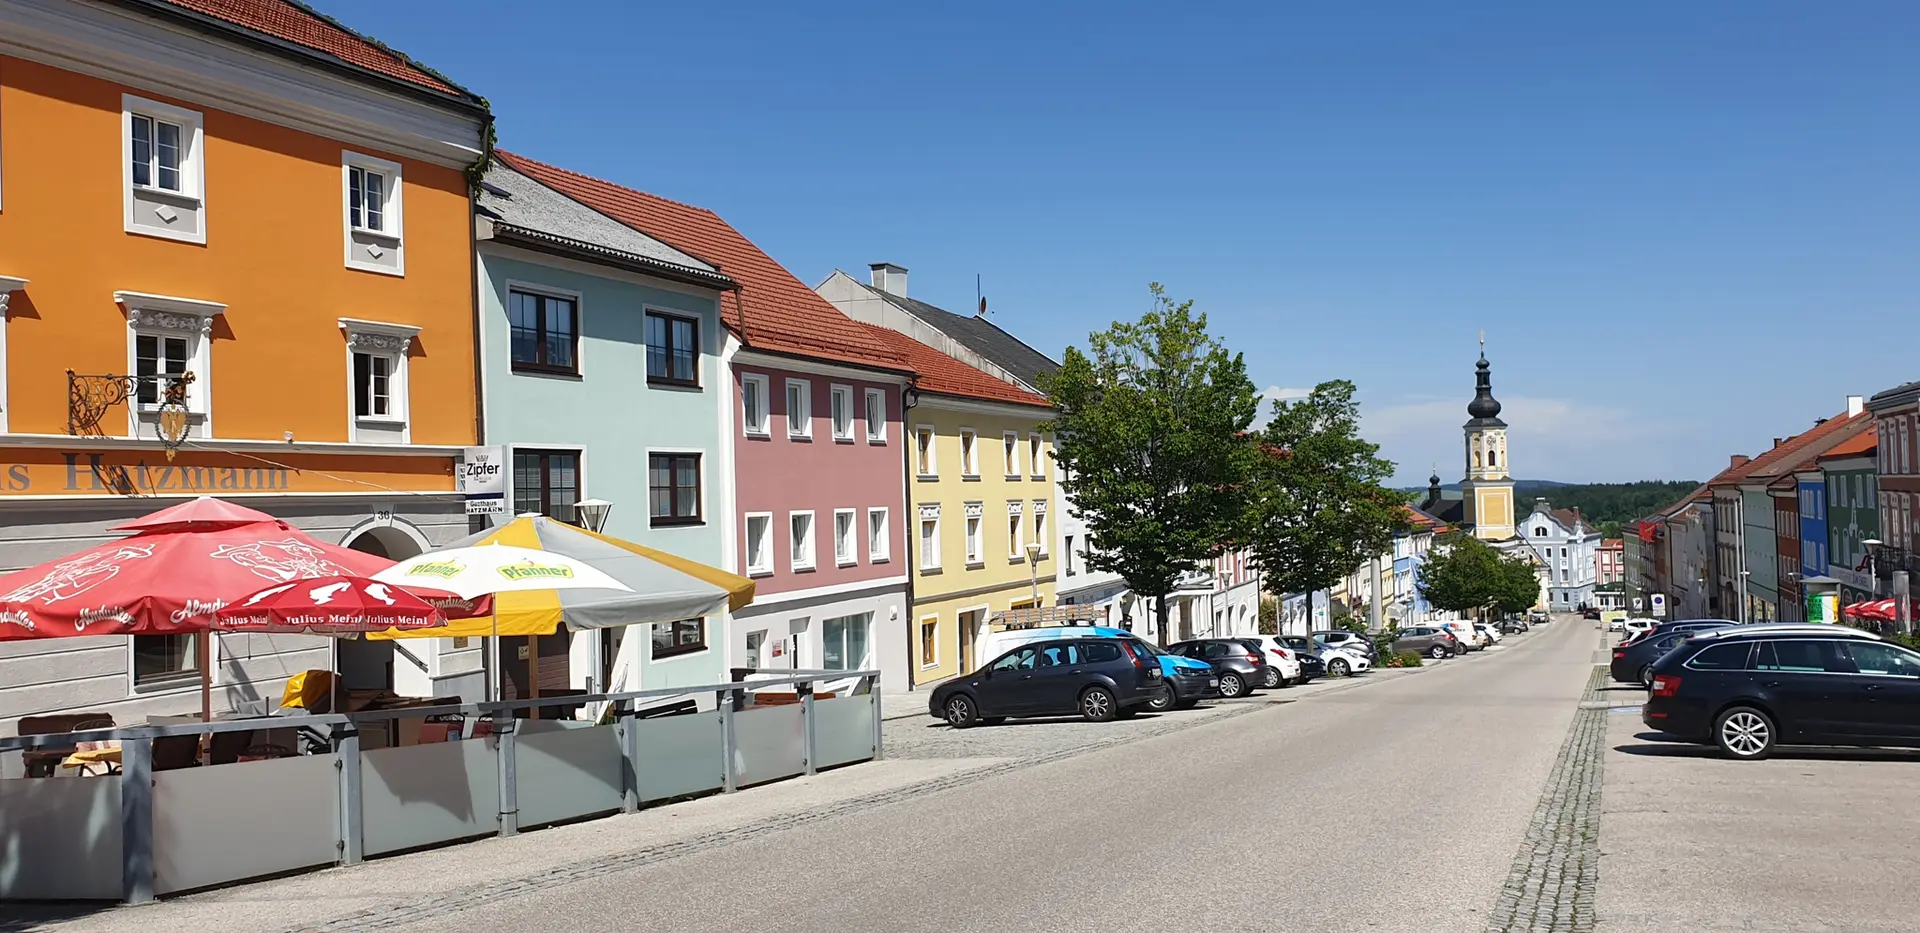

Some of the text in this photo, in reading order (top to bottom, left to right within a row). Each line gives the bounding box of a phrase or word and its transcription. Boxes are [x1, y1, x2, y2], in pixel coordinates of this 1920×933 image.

[0, 452, 290, 493] s Hatzmann
[466, 462, 500, 478] Zipfer
[377, 510, 390, 520] 36
[284, 614, 325, 625] Julius
[397, 615, 428, 625] Meinl
